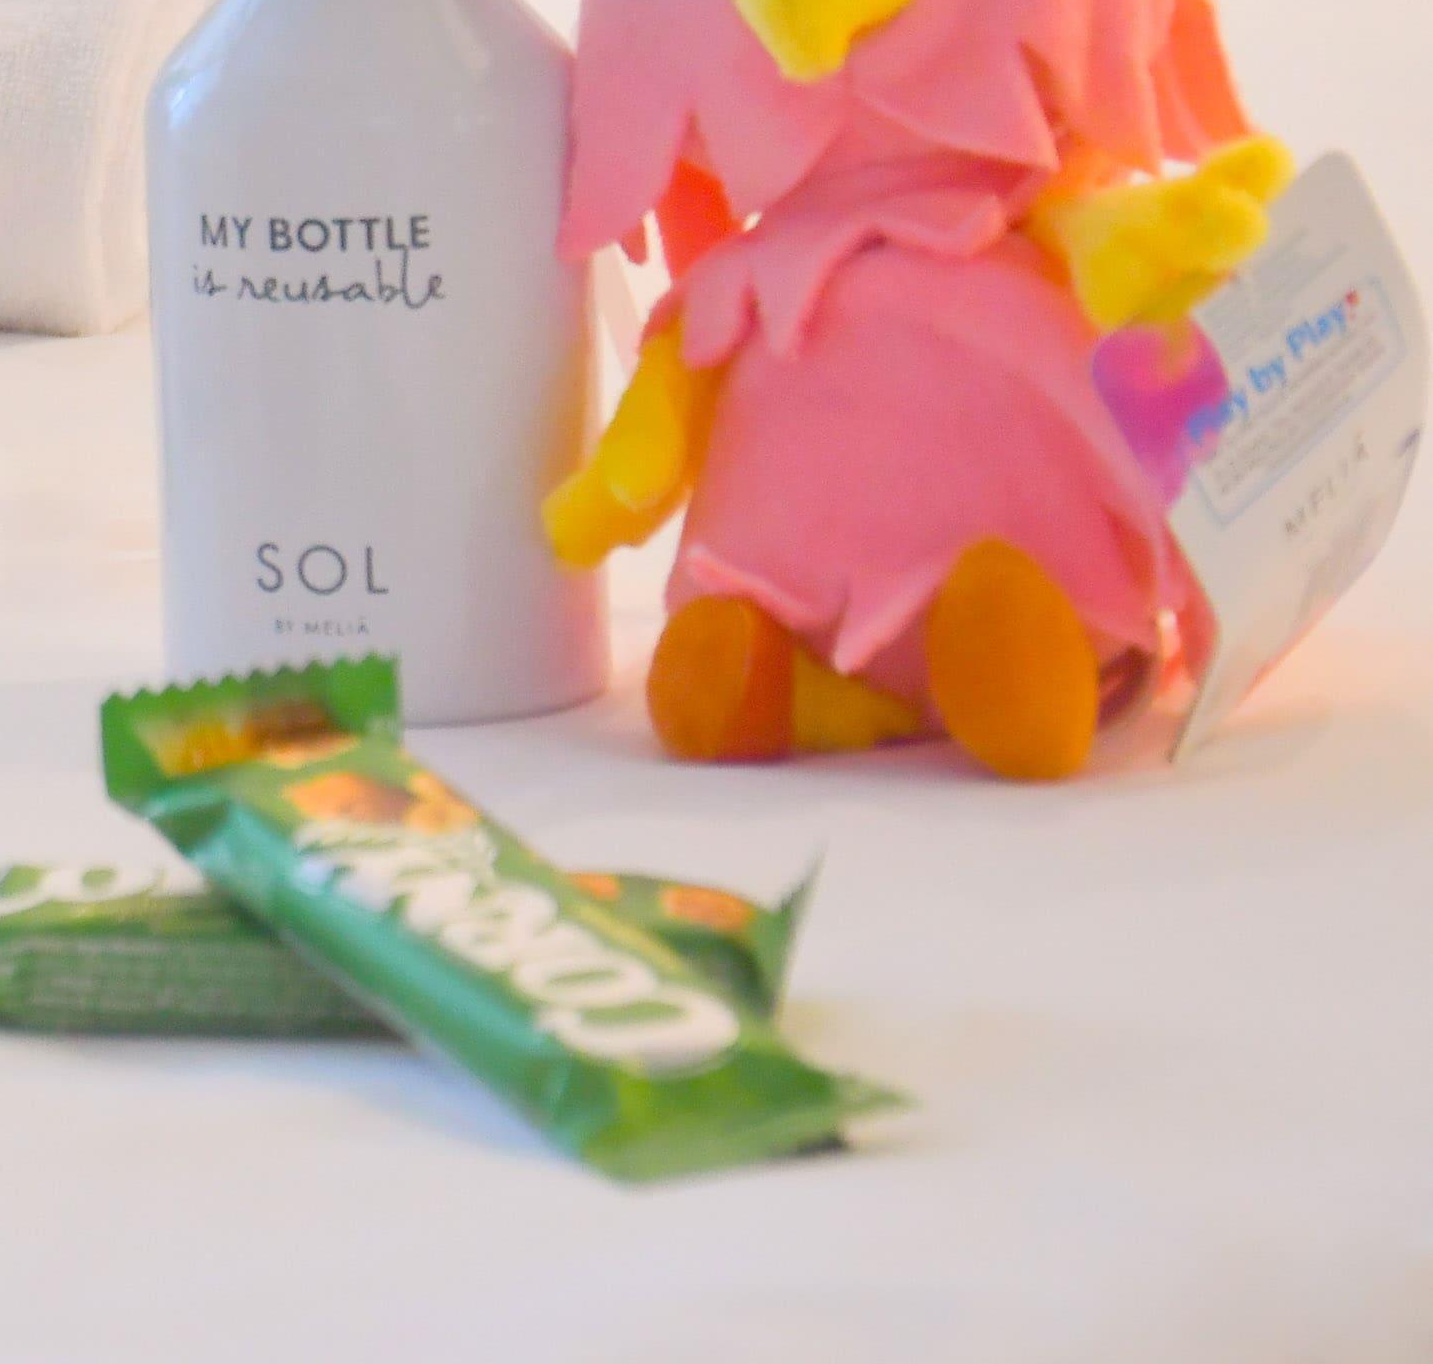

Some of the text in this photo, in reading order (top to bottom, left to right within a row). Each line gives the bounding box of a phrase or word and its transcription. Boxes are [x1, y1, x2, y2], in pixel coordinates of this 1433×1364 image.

[201, 214, 430, 252] MY BOTTLE
[193, 248, 445, 309] is reusable
[256, 542, 389, 596] SOL
